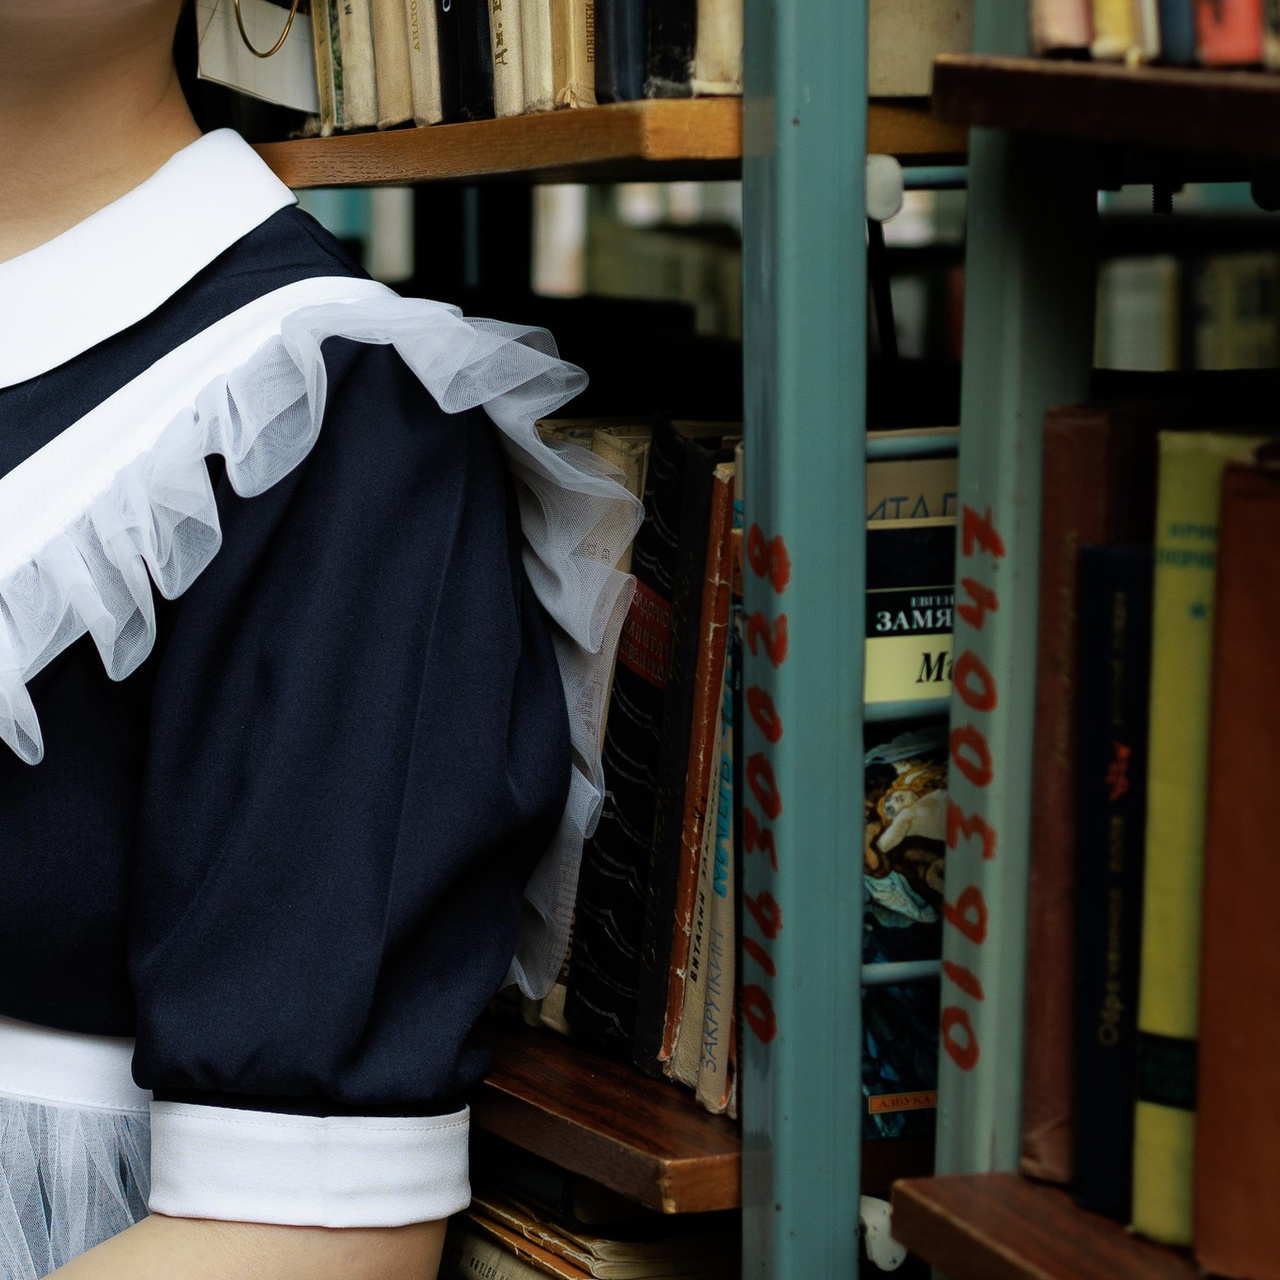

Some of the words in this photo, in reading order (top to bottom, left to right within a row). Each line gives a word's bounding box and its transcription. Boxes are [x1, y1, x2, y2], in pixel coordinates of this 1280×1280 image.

[700, 929, 724, 1075] ЗАКРУТКИН
[742, 523, 791, 1043] 01630028
[941, 505, 1005, 1071] 01630047
